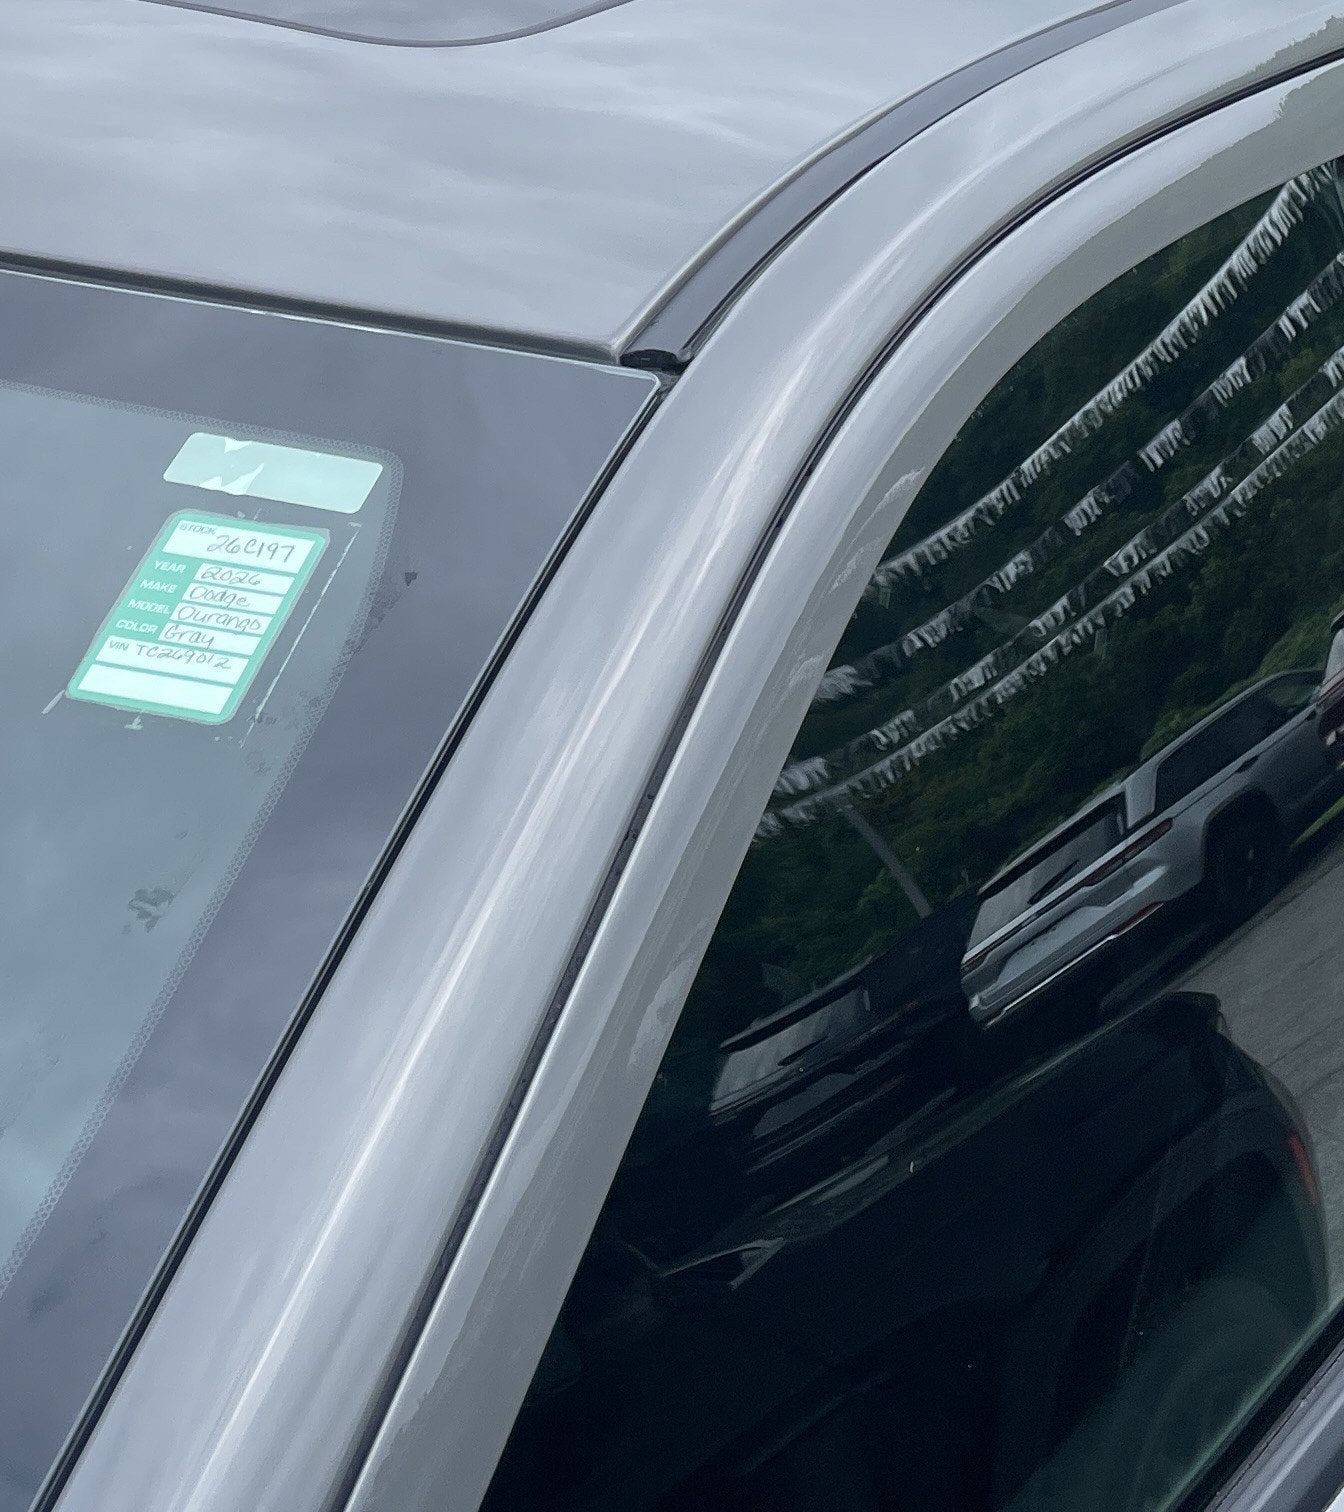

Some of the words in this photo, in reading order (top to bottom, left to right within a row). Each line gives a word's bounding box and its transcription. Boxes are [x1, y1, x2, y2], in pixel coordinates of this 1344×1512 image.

[206, 534, 297, 563] 26C197
[154, 560, 187, 574] YEAR
[201, 566, 261, 586] 2026
[139, 579, 179, 594] MAKE
[189, 586, 251, 609] Dodge
[127, 598, 172, 615] MODEL
[115, 619, 159, 635] COLOR
[108, 639, 129, 651] VIN
[163, 624, 215, 649] Gray
